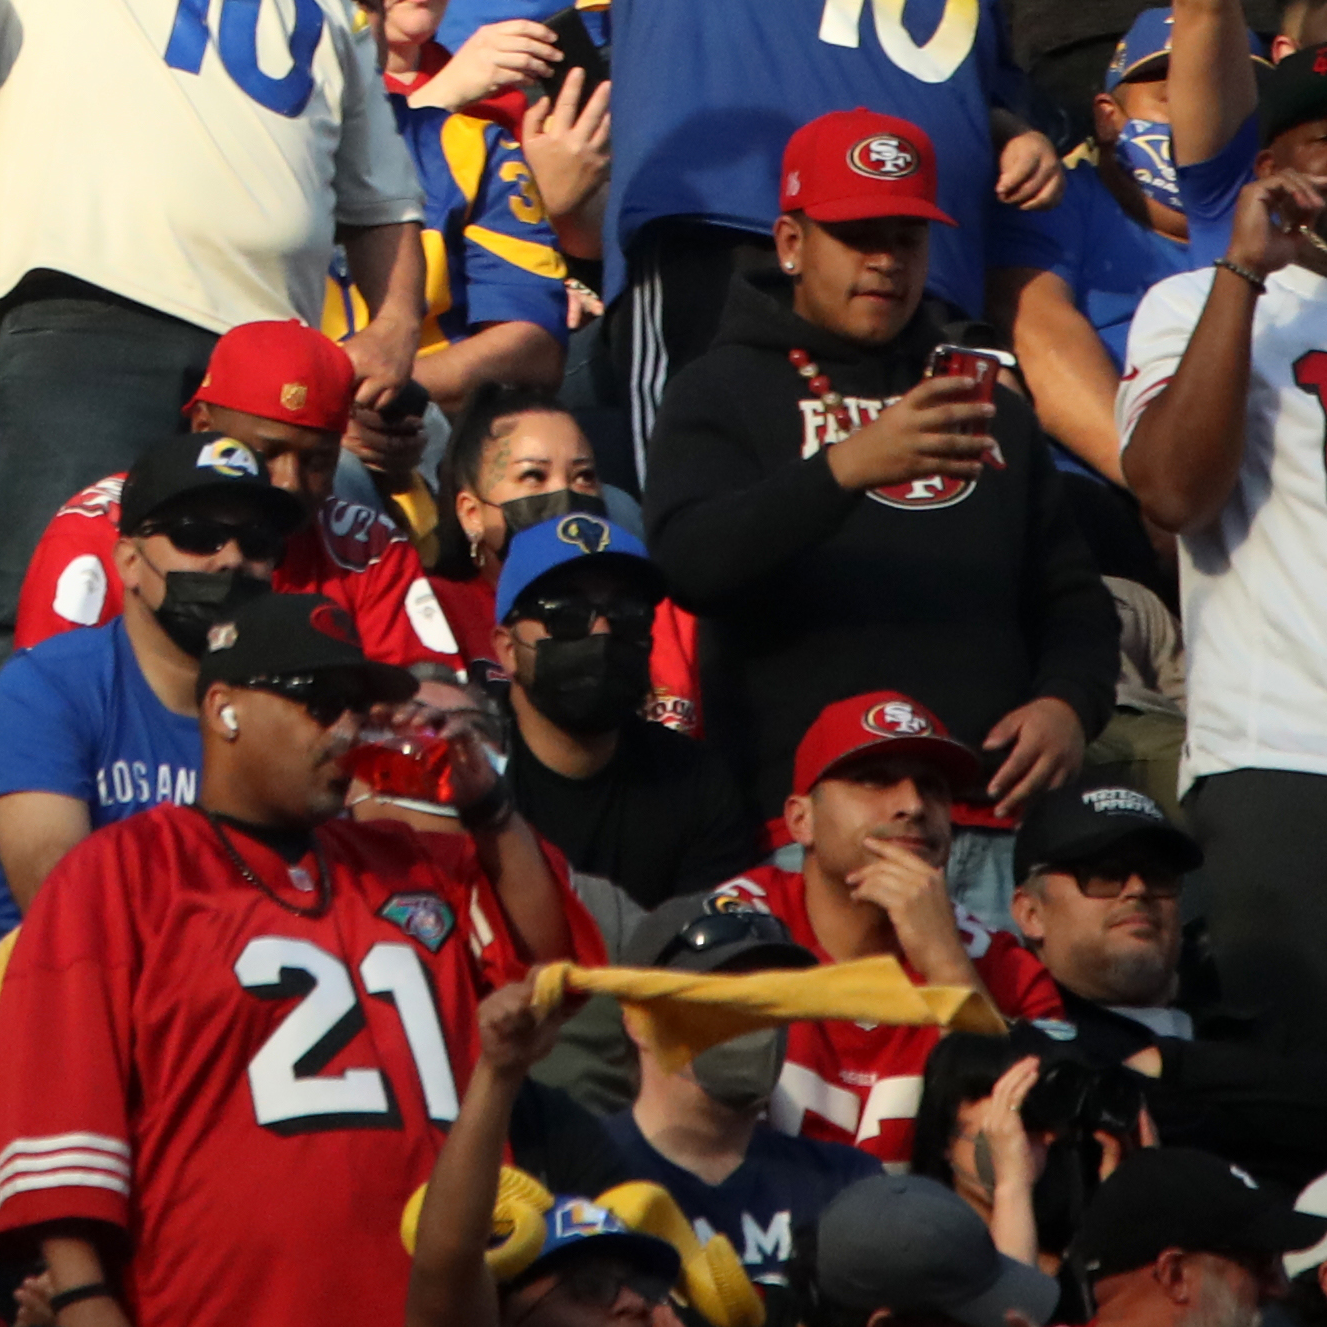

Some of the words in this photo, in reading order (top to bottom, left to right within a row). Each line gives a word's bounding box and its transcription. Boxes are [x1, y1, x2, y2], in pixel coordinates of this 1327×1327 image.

[869, 139, 913, 173] SF
[96, 759, 151, 807] LOS
[233, 934, 461, 1135] 21
